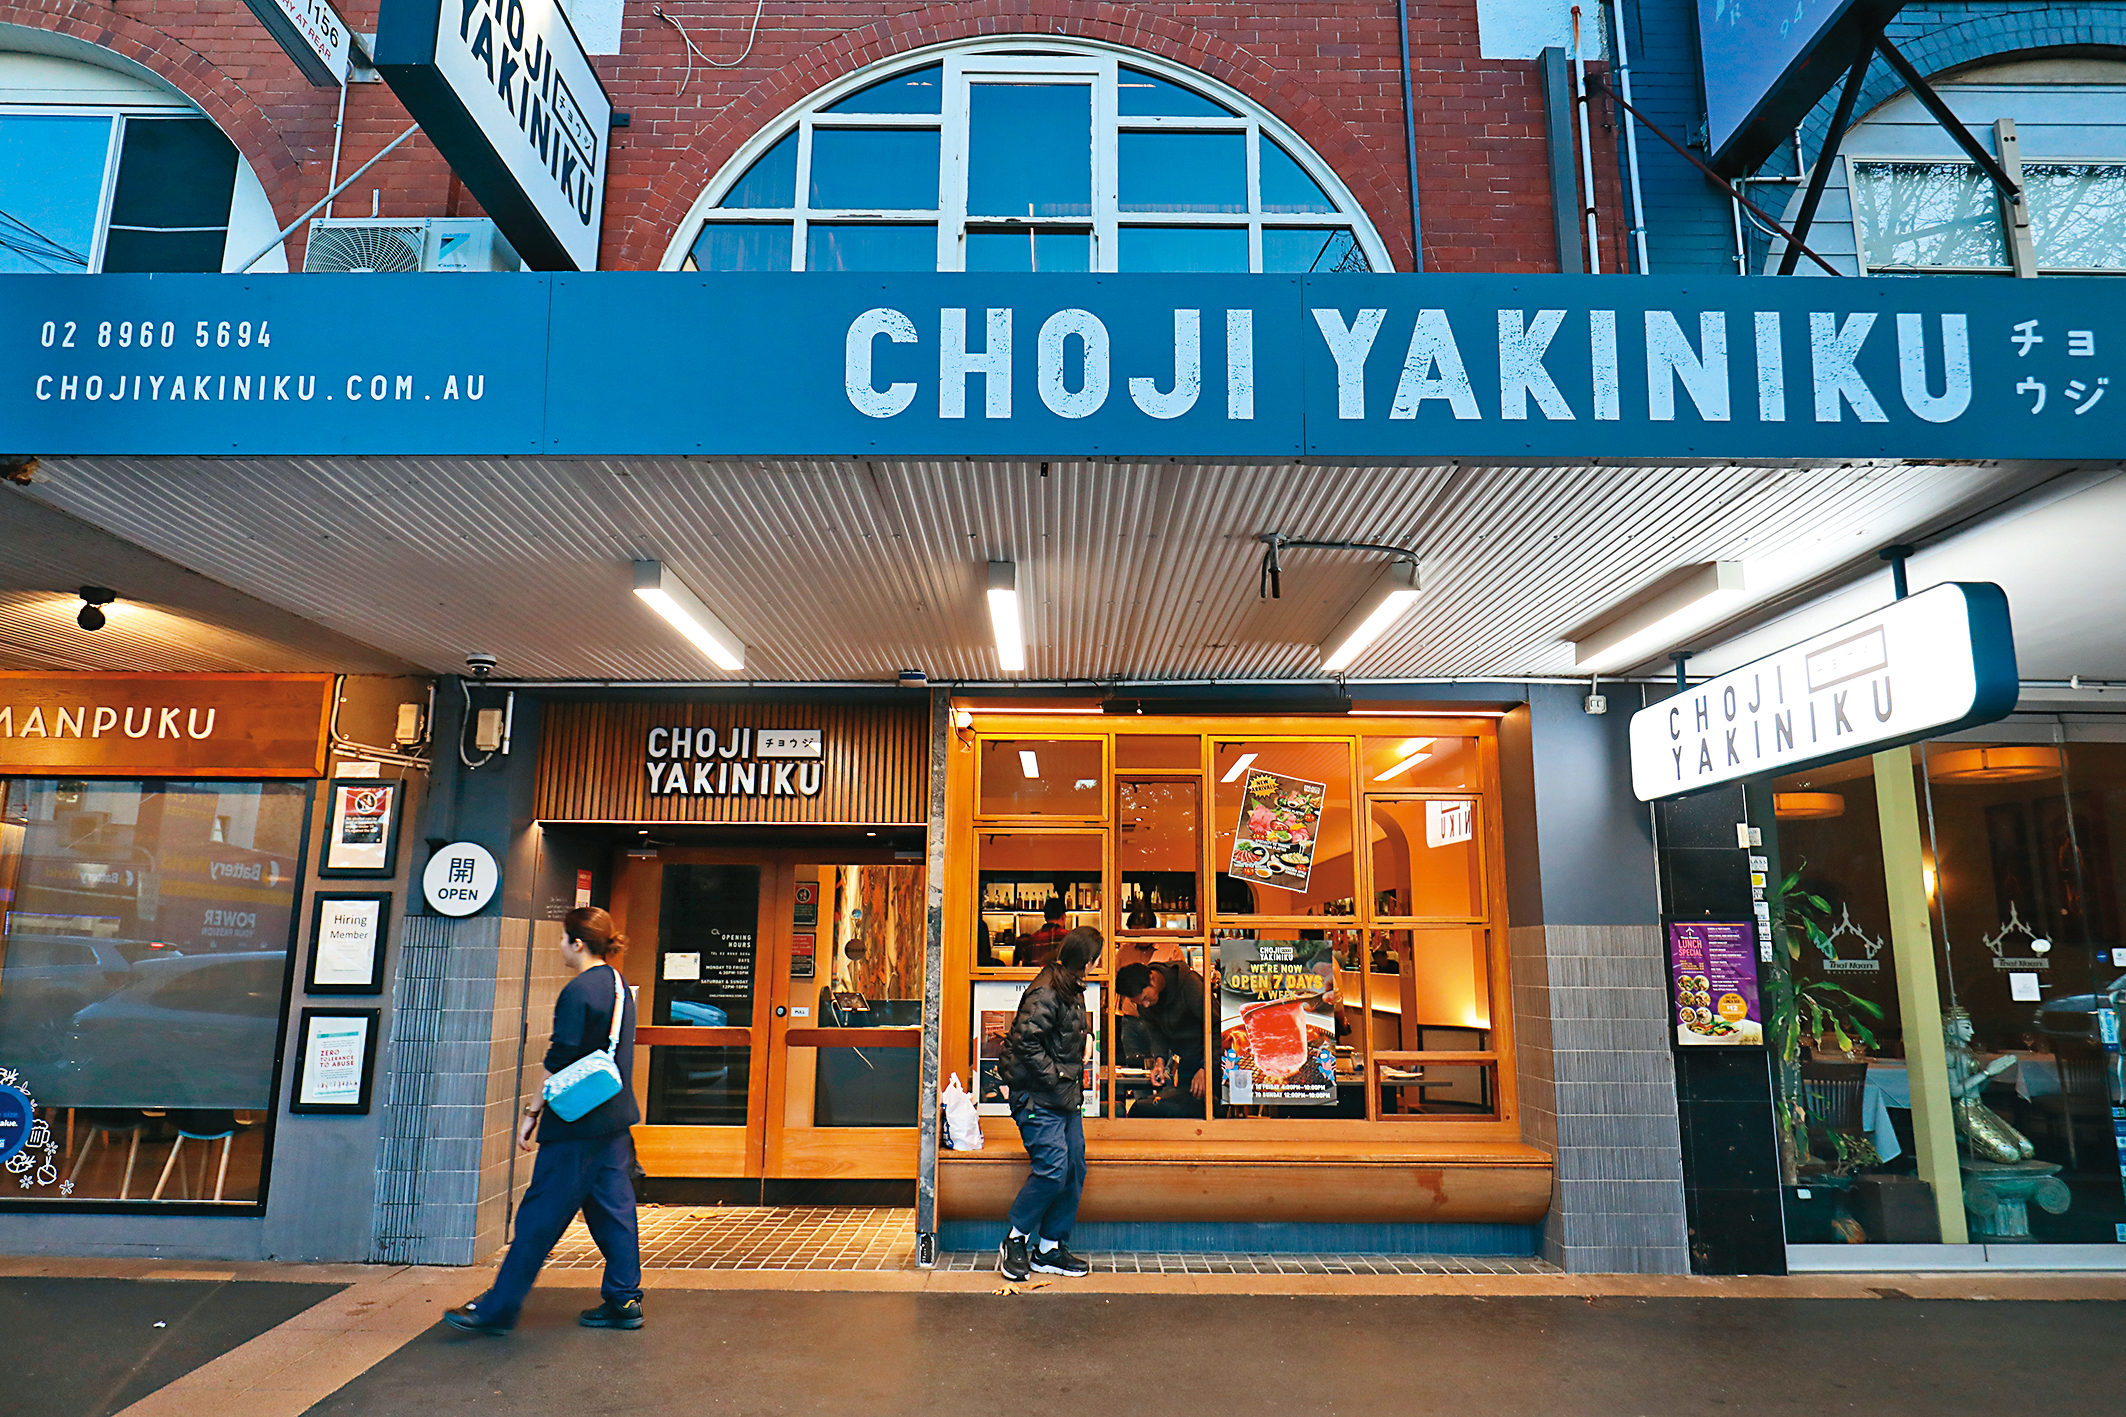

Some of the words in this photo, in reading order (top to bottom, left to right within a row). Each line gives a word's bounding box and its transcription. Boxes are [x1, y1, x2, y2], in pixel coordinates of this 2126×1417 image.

[296, 14, 309, 29] AT
[308, 28, 332, 61] REAR
[484, 0, 552, 104] OJI
[40, 321, 77, 348] 02
[98, 321, 176, 348] 8960
[195, 321, 272, 348] 5694
[845, 307, 1254, 420] CHOJI
[1310, 308, 1972, 423] YAKINIKU
[35, 374, 487, 401] CHOJIYAKINIKU.COM.AU
[1669, 665, 1784, 741] CHOJI
[1671, 675, 1893, 781] YAKINIKU
[648, 727, 751, 760] CHOJI
[646, 762, 822, 796] YAKINIKU
[448, 857, 475, 884] 開
[438, 888, 479, 900] OPEN
[334, 914, 368, 928] Hiring
[329, 930, 368, 939] Member
[1259, 946, 1280, 954] CHOJI
[1677, 939, 1703, 949] LUNCH
[1259, 953, 1294, 961] YAKINIKU
[1678, 948, 1703, 957] SPECIAL
[1250, 963, 1278, 974] WE'RE
[1281, 963, 1303, 974] NOW
[1829, 960, 1848, 969] Thai
[1231, 974, 1269, 989] OPEN
[1272, 973, 1284, 990] 7
[1285, 973, 1324, 990] DAYS
[1257, 990, 1265, 1000] A
[1268, 990, 1298, 1000] WEEK
[320, 1049, 340, 1057] ZERO
